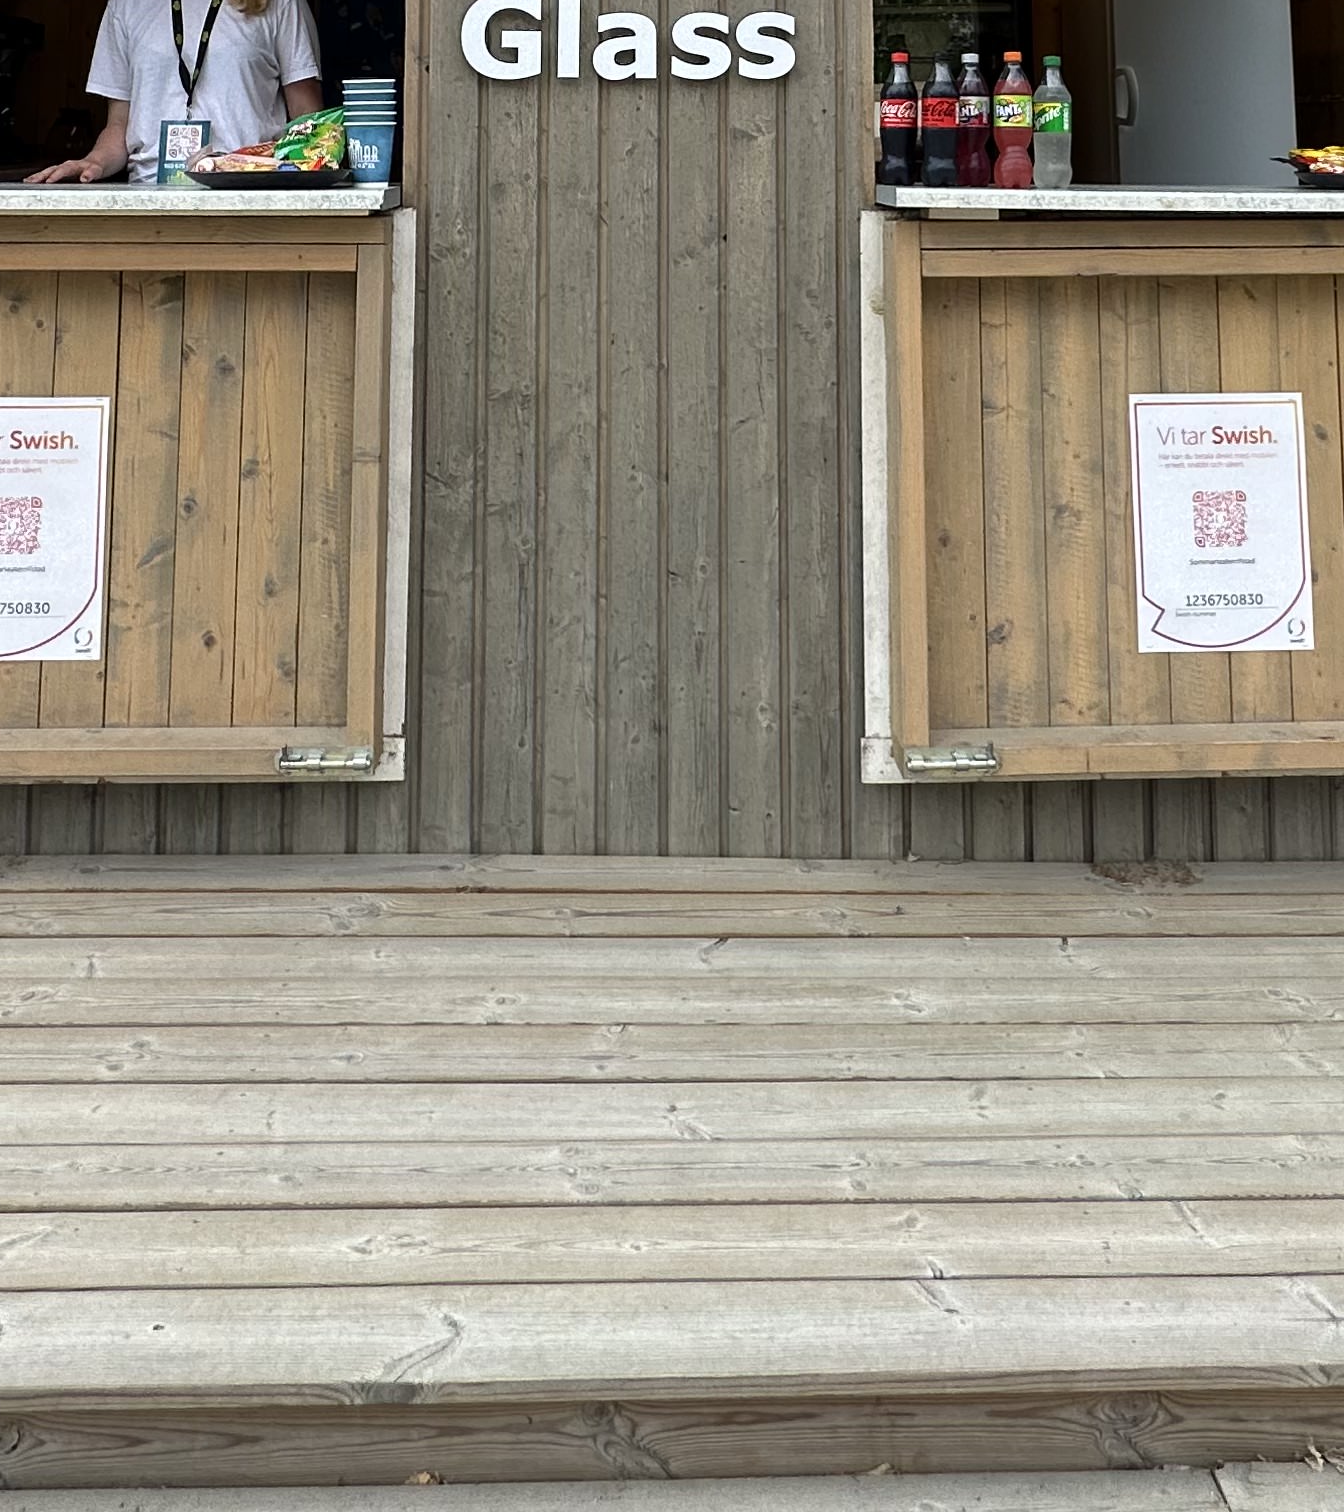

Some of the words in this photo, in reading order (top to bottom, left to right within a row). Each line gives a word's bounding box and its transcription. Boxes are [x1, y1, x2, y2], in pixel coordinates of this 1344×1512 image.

[9, 429, 79, 450] Swish.
[1156, 425, 1176, 446] Vi
[1180, 428, 1208, 446] tar
[1211, 425, 1279, 445] Swish.
[1185, 593, 1264, 607] 1236750830
